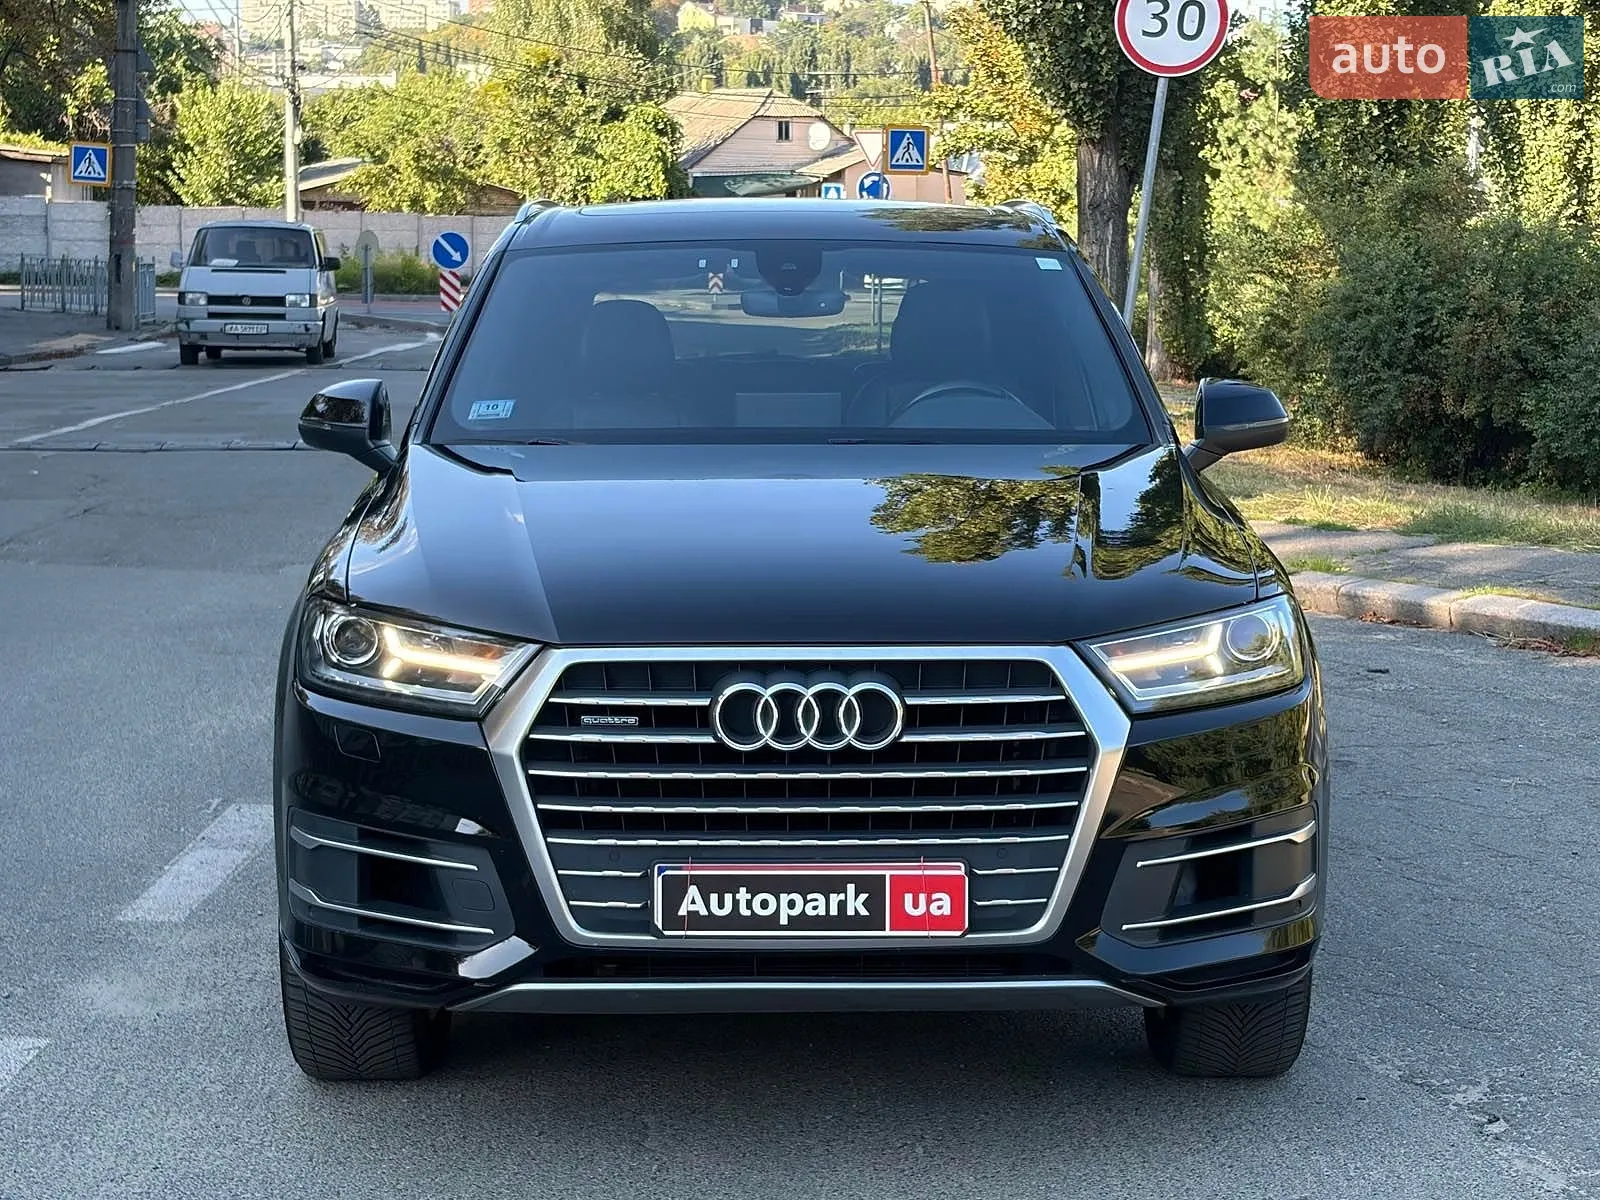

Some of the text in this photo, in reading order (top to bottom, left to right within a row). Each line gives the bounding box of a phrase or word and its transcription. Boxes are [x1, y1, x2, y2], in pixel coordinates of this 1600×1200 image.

[1142, 0, 1206, 41] 30
[486, 403, 499, 411] 10
[583, 717, 636, 725] quattro
[677, 883, 951, 925] Autopark ua
